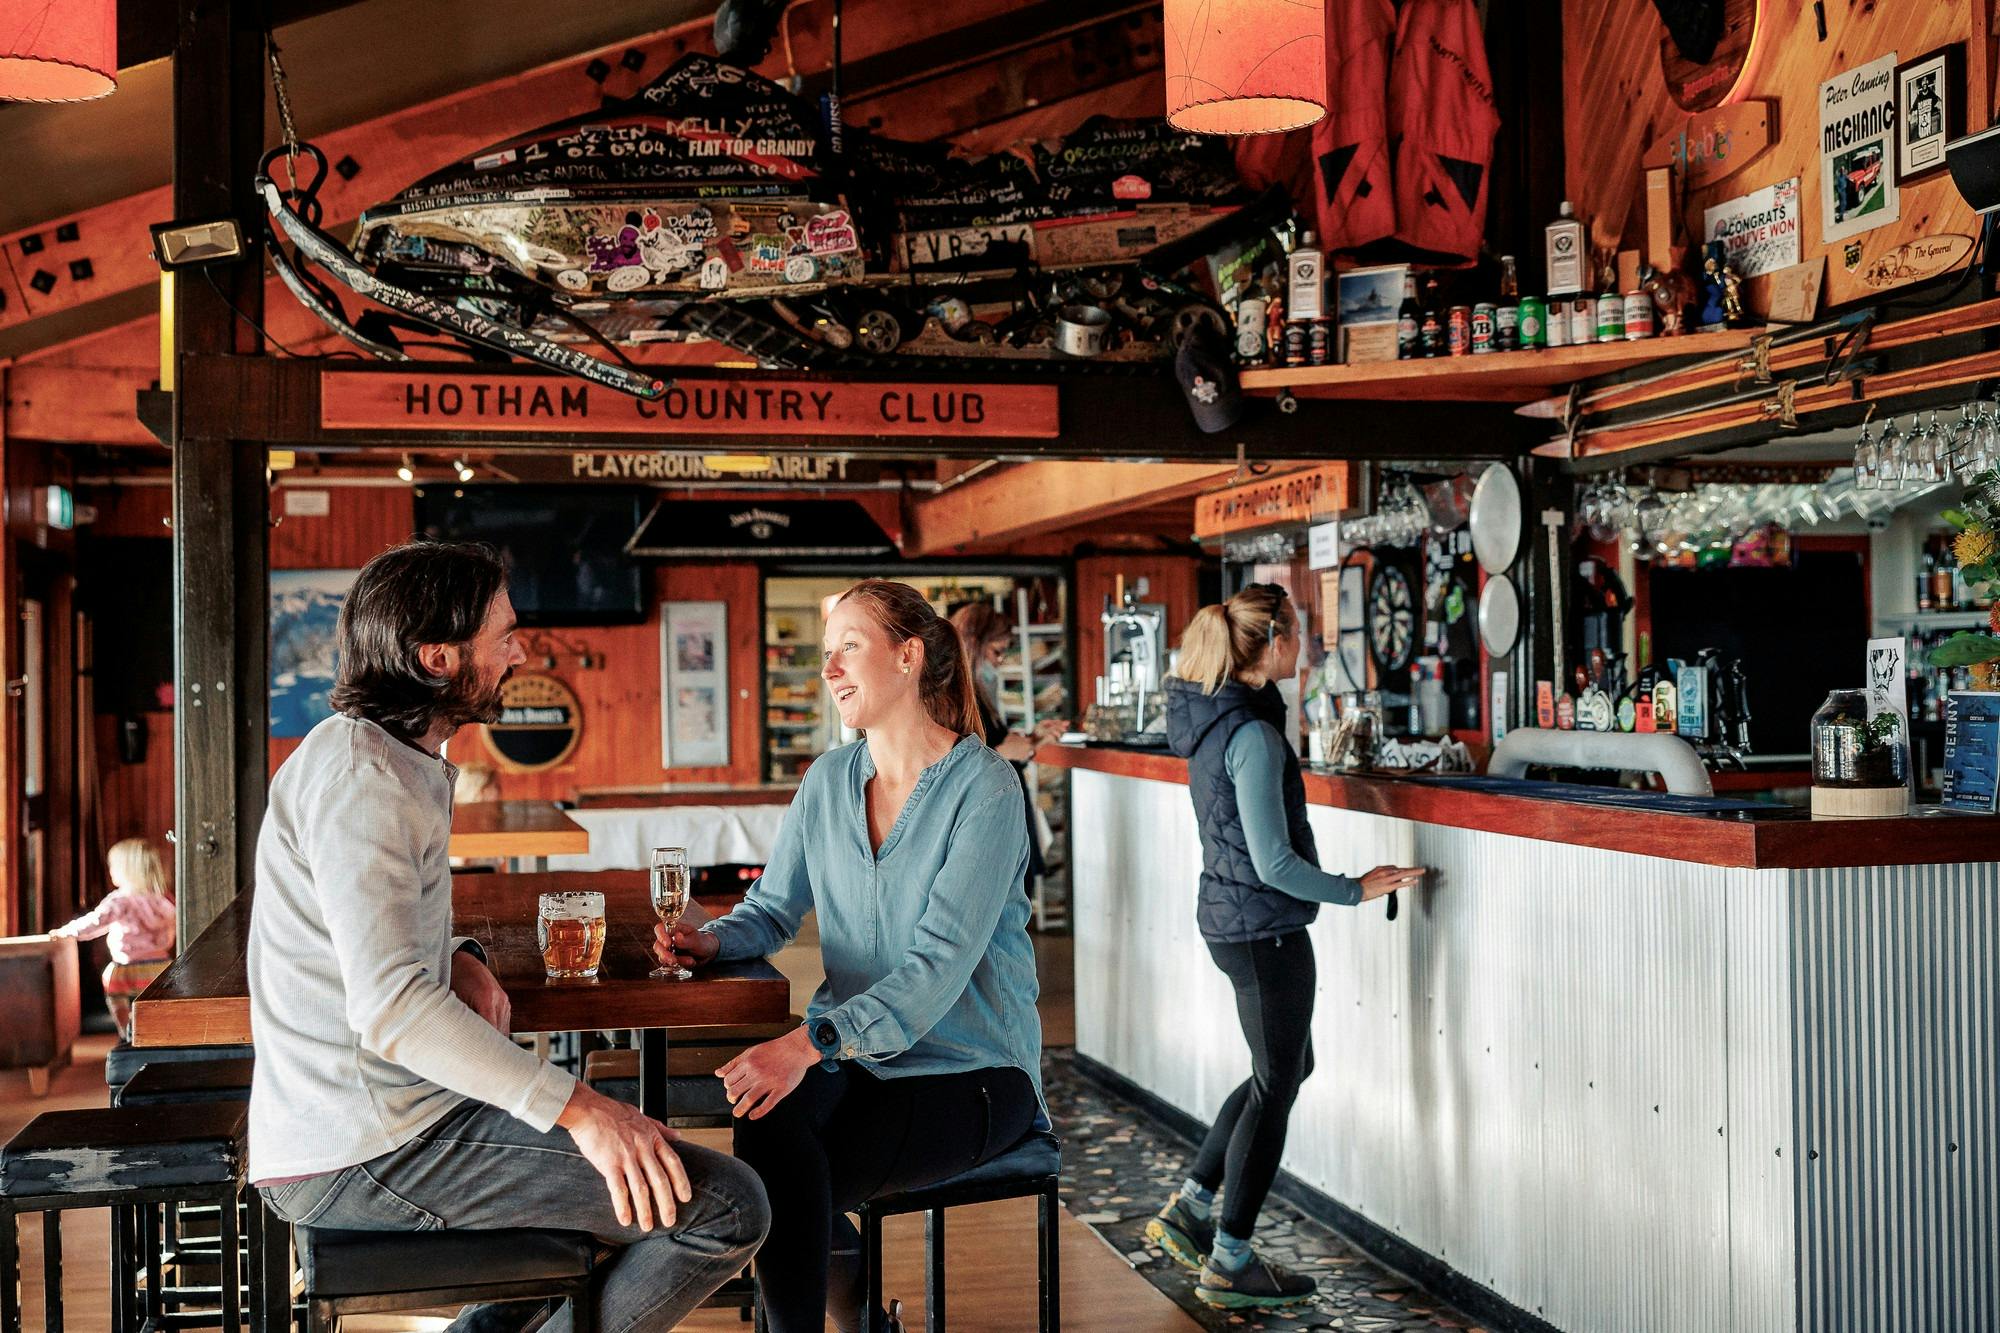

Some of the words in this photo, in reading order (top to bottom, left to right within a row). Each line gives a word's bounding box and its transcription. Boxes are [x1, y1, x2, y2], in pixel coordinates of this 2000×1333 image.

[1826, 85, 1849, 108] Peter
[1851, 70, 1890, 98] Canning
[1824, 100, 1896, 154] MECHANIC
[688, 140, 722, 157] FLAT
[725, 140, 752, 157] TOP
[756, 139, 816, 157] GRANDY
[1728, 205, 1786, 237] CONGRATS
[1769, 217, 1795, 238] WON
[1928, 239, 1954, 258] General
[405, 384, 588, 417] HOTHAM
[636, 388, 833, 421] COUNTRY
[879, 393, 986, 424] CLUB
[1945, 697, 1959, 759] GENNY
[1943, 768, 1954, 803] THE
